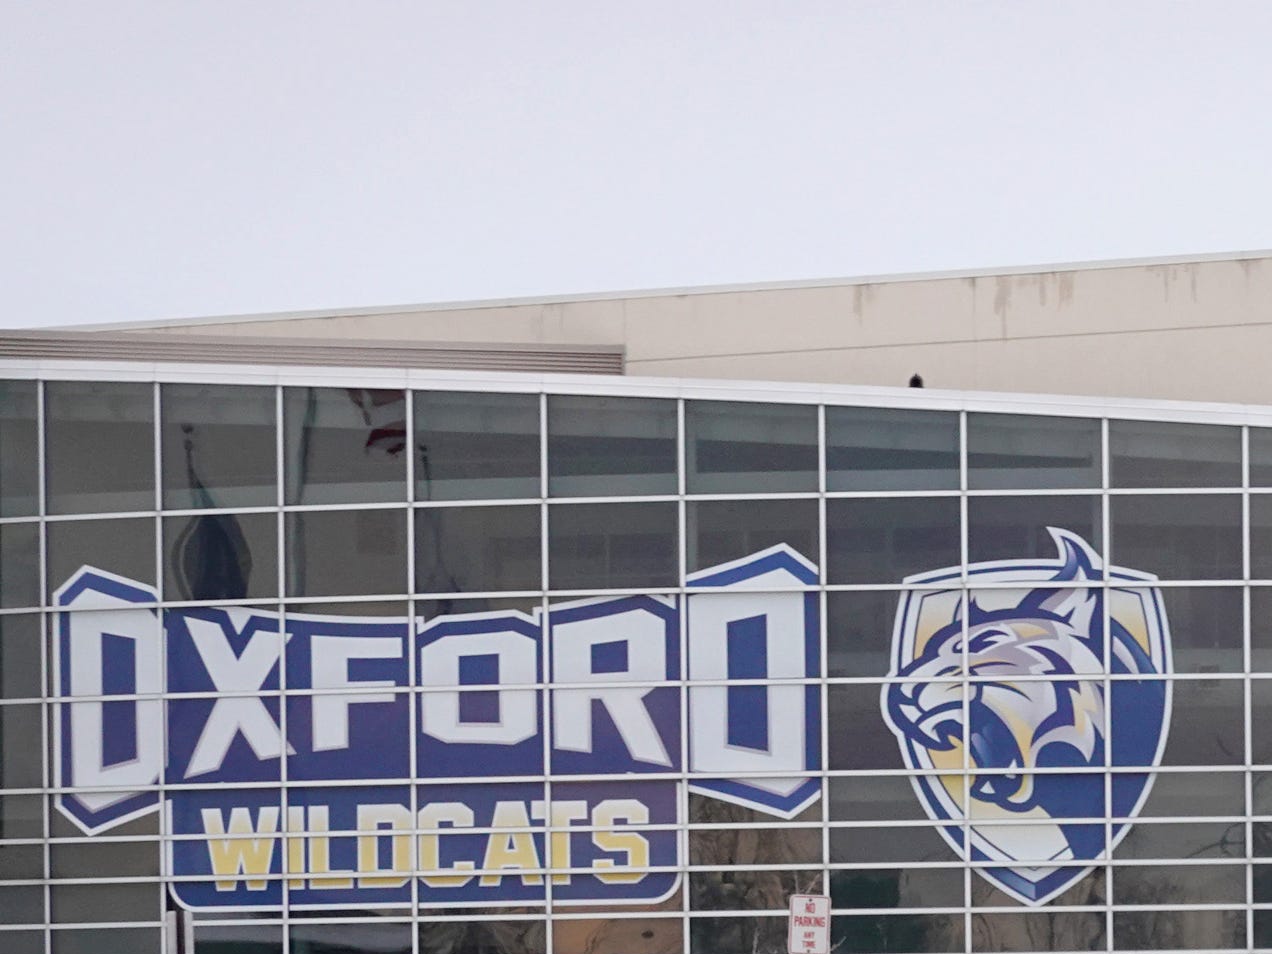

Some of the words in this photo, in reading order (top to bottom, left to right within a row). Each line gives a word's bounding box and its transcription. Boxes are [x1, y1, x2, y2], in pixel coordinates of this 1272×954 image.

[66, 560, 812, 805] OXFORD
[202, 800, 651, 892] WILDCATS
[794, 916, 825, 927] PARKING
[805, 903, 816, 914] NO
